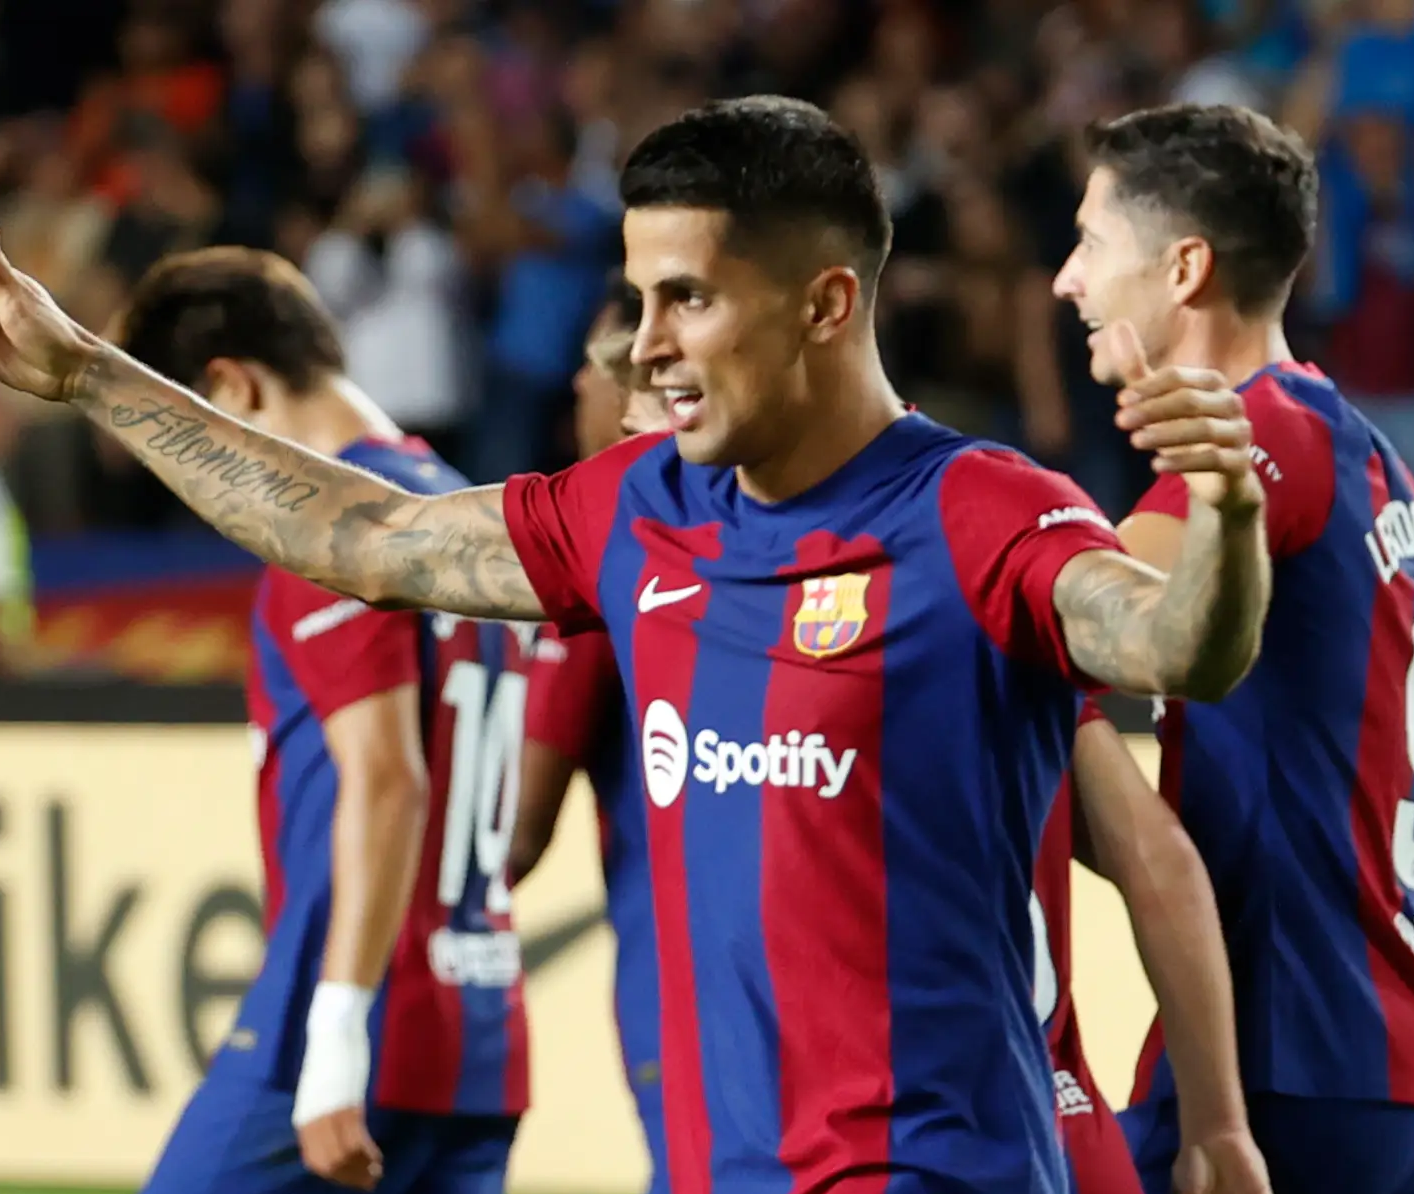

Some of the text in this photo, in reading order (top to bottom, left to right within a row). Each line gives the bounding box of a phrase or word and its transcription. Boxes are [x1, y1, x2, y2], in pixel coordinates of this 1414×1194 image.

[111, 397, 321, 513] Filomena
[439, 660, 527, 911] 14
[692, 728, 857, 799] Spotify
